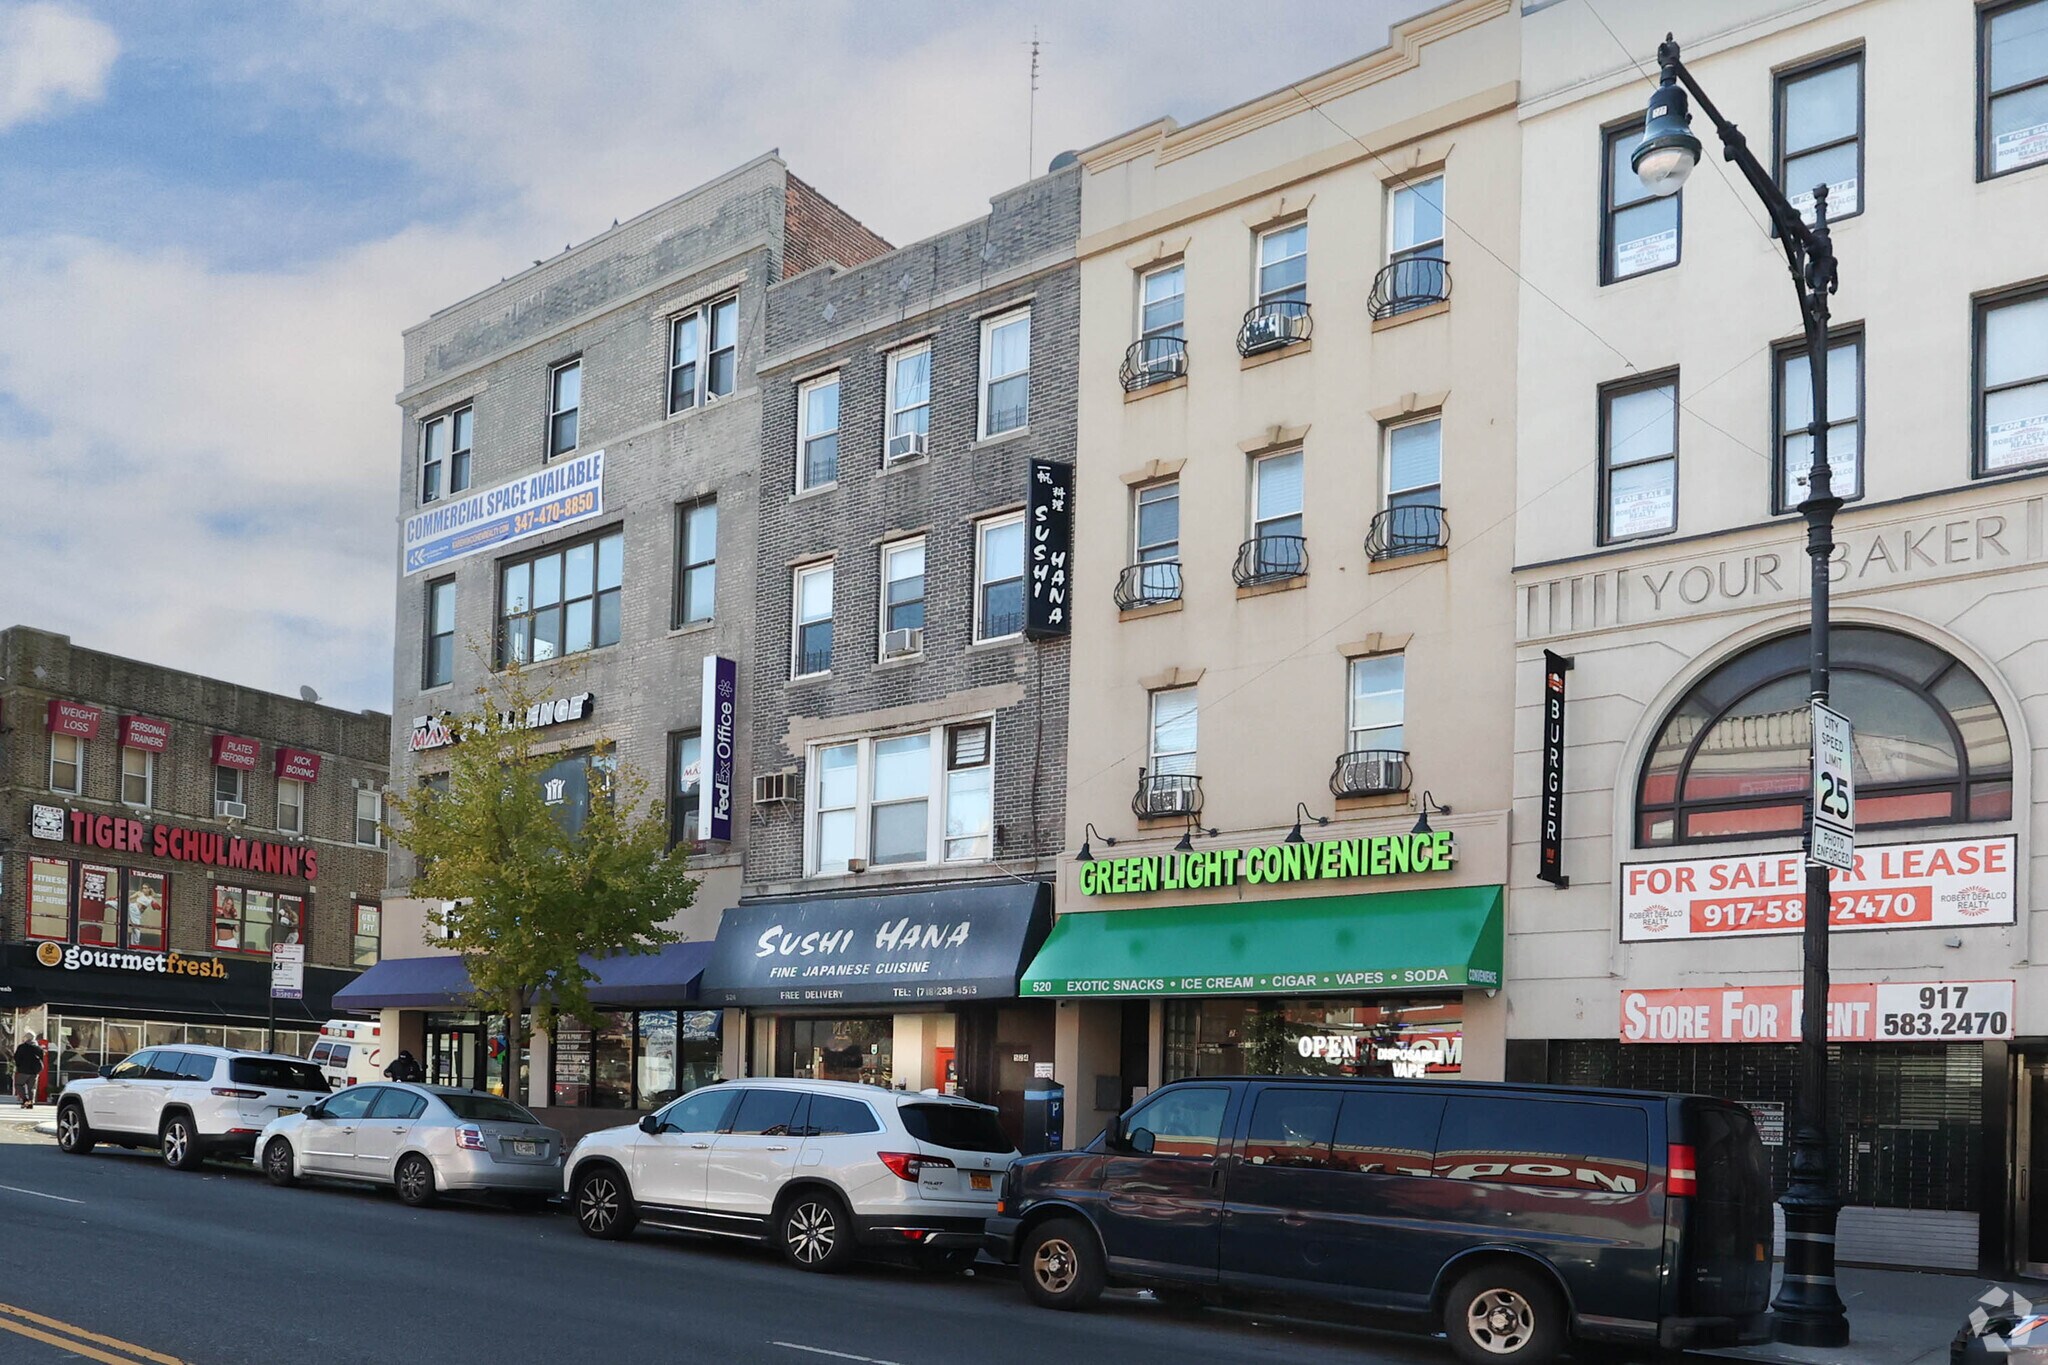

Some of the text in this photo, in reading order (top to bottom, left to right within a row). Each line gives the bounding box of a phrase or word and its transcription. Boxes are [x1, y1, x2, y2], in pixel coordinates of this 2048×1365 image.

[407, 496, 485, 543] COMMERCIAL
[487, 480, 528, 517] SPACE
[530, 454, 601, 502] AVAILABLE
[514, 491, 594, 533] 347-470-8850
[1033, 505, 1050, 598] SUSHI
[1048, 551, 1066, 624] HANA
[1642, 553, 1783, 610] YOUR
[60, 705, 99, 721] WEIGHT
[64, 720, 89, 732] LOSS
[130, 720, 167, 736] PERSONAL
[1823, 715, 1839, 734] CITY
[130, 732, 164, 747] TRAINERS
[227, 741, 254, 754] PILATES
[1821, 732, 1844, 753] SPEED
[221, 751, 256, 766] REFORMER
[293, 755, 311, 767] KICK
[714, 701, 733, 821] FedEx Office
[1824, 752, 1843, 771] LIMIT
[286, 764, 315, 778] BOXING
[1546, 699, 1560, 842] BURGER
[1820, 771, 1850, 820] 25
[70, 811, 319, 881] TIGER SCHULMANN'S
[1823, 832, 1845, 850] PHOTO
[1816, 843, 1851, 865] ENFORCED
[1079, 831, 1454, 896] GREEN LIGHT CONVENIENCE
[1629, 866, 1697, 896] FOR
[1709, 858, 1798, 891] SALE
[1881, 844, 2007, 880] LEASE
[33, 873, 68, 886] FITNESS
[132, 870, 164, 880] TSK.COM
[279, 893, 302, 902] FITNESS
[1940, 891, 2007, 902] ROBERT DEFALCO
[1957, 900, 1989, 909] REALTY
[361, 913, 377, 923] GET
[1629, 909, 1683, 919] ROBERT DEFALCO
[1642, 917, 1669, 926] REALTY
[363, 922, 375, 932] FIT
[755, 917, 971, 958] SUSHI HANA
[770, 961, 931, 979] FINE JAPANESE CUISINE
[1032, 968, 1498, 992] 520 EXOTIC SNACKS ICE CREAM CIGAR VAPES SODA CONVENIENCE
[780, 991, 800, 1000] FREE
[805, 990, 845, 999] DELIVERY
[893, 987, 911, 997] TEL:
[1919, 986, 1968, 1010] 917
[1625, 992, 1710, 1040] STORE
[1722, 990, 1778, 1040] FOR
[1884, 1011, 2008, 1036] 583.2470
[1298, 1035, 1359, 1059] OPEN
[1377, 1047, 1445, 1065] DISPOSABLE
[1392, 1062, 1426, 1079] VAPE
